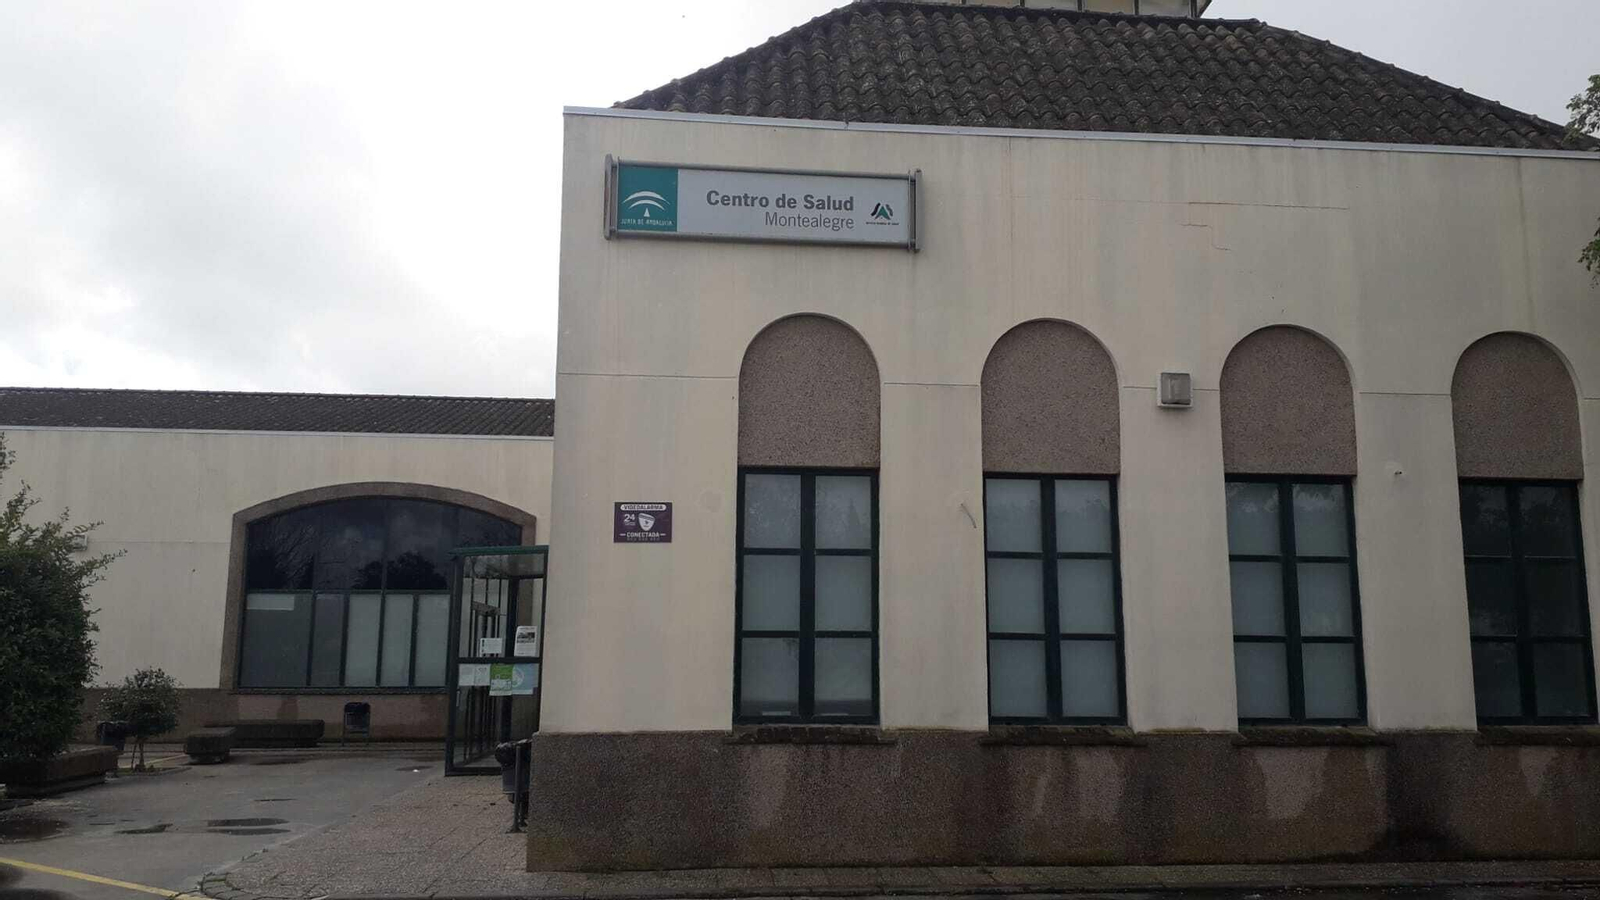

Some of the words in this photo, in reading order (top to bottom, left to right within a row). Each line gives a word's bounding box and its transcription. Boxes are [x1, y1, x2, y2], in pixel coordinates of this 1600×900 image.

[706, 190, 770, 208] Centro
[775, 194, 798, 209] de
[803, 196, 854, 211] Salud
[765, 211, 855, 232] Montealegre
[624, 514, 636, 522] 24
